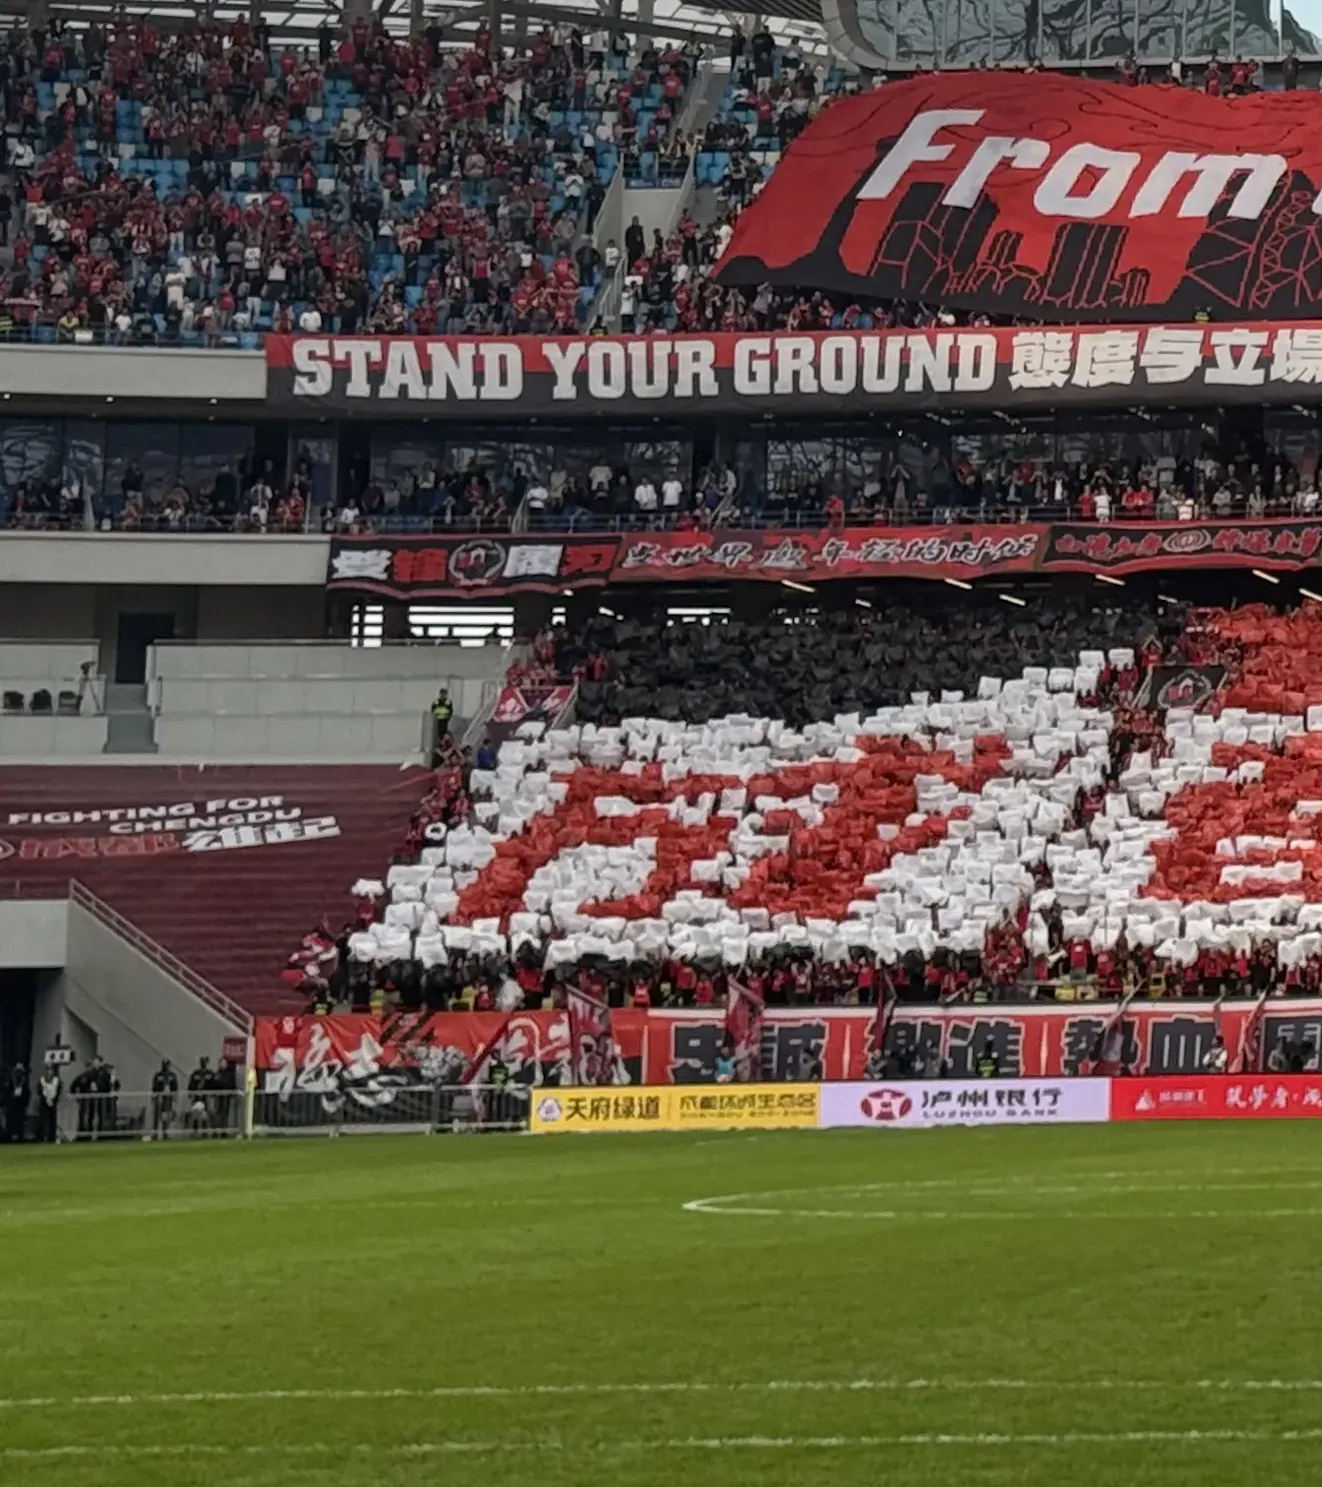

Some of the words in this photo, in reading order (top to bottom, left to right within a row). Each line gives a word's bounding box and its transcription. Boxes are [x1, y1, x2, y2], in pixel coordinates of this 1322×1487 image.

[856, 109, 1287, 219] From
[291, 339, 523, 400] STAND
[541, 339, 719, 400] YOUR
[734, 334, 997, 394] GROUND
[8, 802, 196, 825] FIGHTING
[206, 794, 284, 813] FOR
[110, 807, 301, 834] CHENGDU
